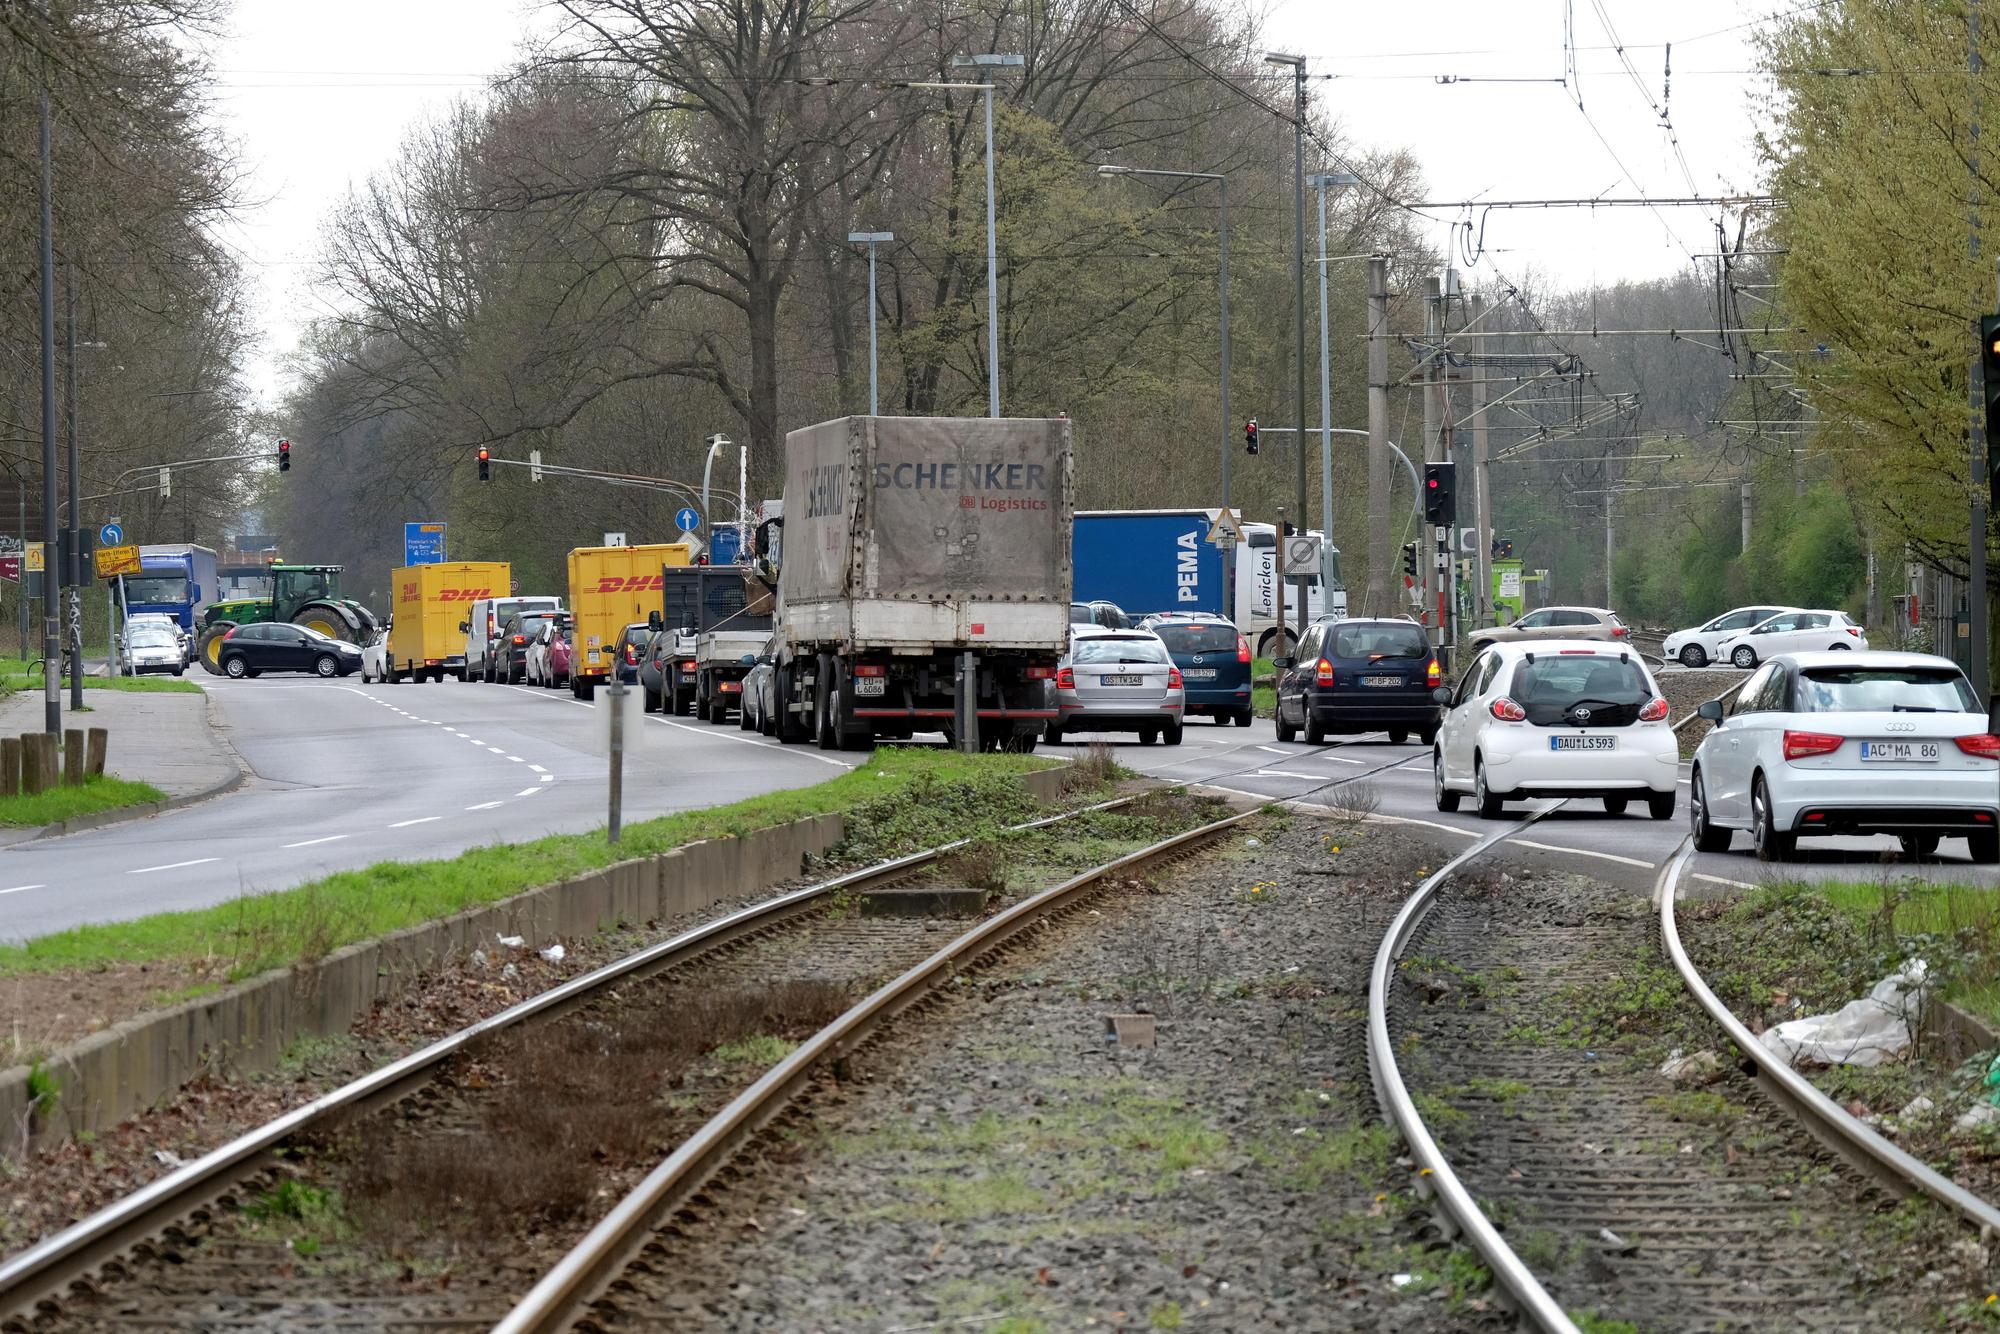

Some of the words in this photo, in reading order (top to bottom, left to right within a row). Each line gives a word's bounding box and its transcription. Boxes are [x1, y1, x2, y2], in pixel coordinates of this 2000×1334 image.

[876, 463, 1046, 490] SCHENKER
[981, 496, 1047, 512] Logistics
[1177, 531, 1199, 602] PEMA
[439, 589, 492, 601] DHL
[1129, 676, 1142, 684] 148
[1388, 677, 1400, 685] 202
[1558, 738, 1575, 748] DAU
[1582, 738, 1594, 748] LS
[1596, 738, 1613, 748] 593
[1870, 744, 1886, 757] AC
[1895, 744, 1911, 757] MA
[1921, 744, 1937, 757] 86
